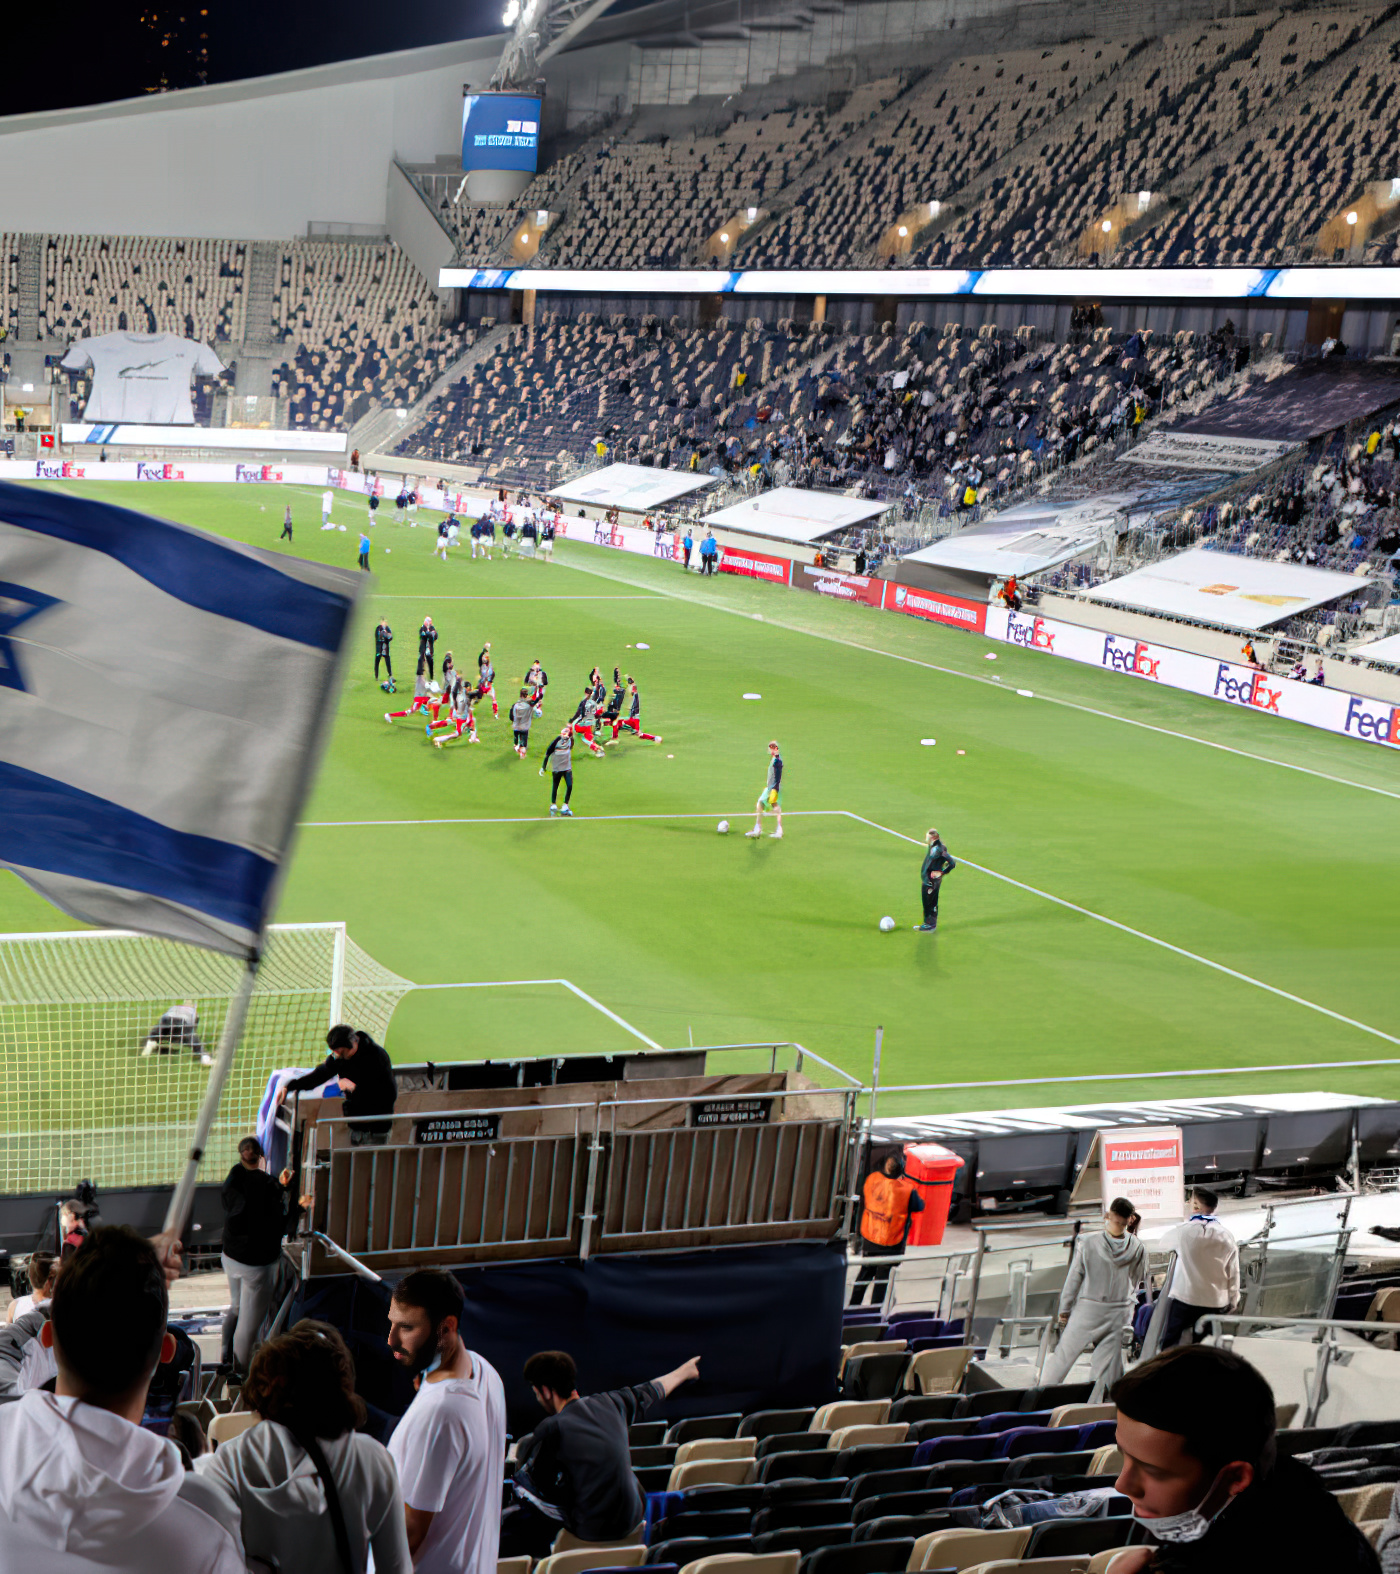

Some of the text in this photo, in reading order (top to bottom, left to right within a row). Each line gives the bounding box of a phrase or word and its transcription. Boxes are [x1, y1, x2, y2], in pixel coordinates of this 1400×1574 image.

[1007, 609, 1055, 652] FedEx
[1102, 634, 1160, 679] FedEx
[1214, 663, 1282, 712] FedEx
[1345, 695, 1400, 746] FedE
